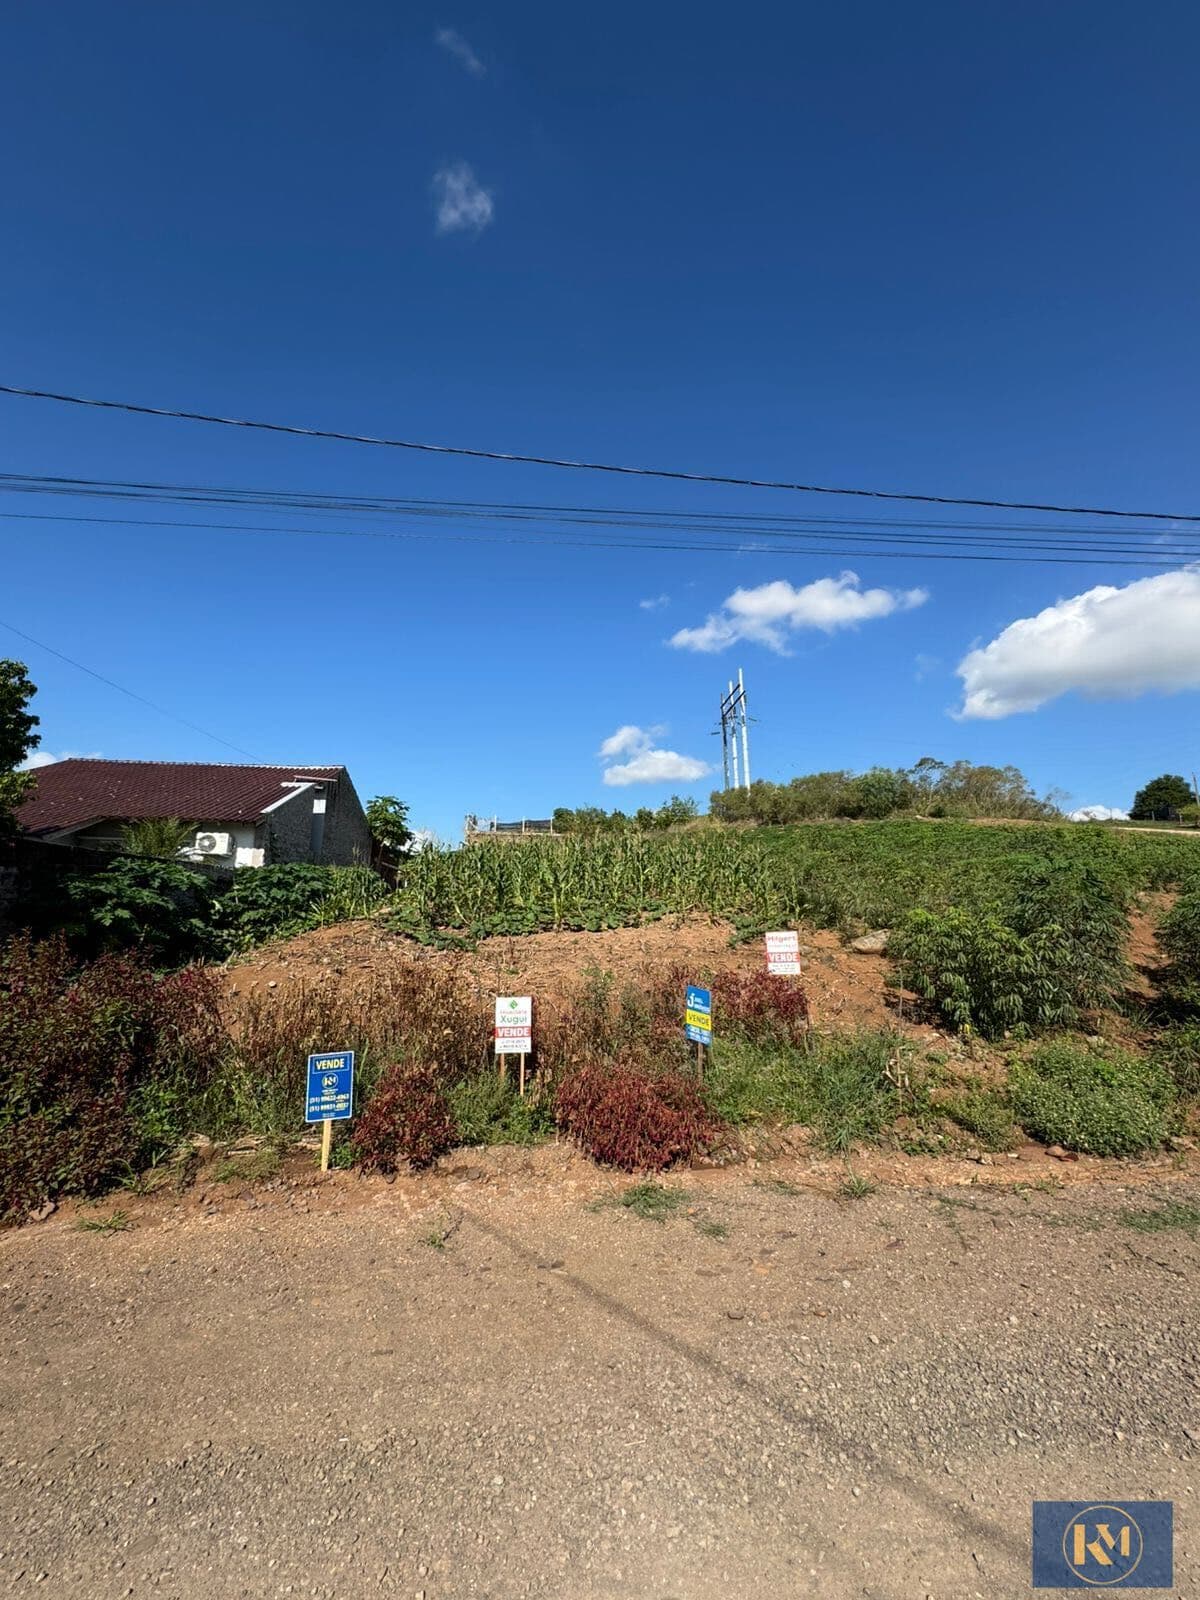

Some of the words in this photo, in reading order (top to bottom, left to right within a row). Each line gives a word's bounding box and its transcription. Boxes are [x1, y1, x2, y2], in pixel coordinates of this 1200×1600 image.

[768, 953, 798, 962] VENDE
[500, 1015, 528, 1025] Xugui
[688, 1012, 710, 1026] VENDE
[498, 1028, 530, 1037] VENDE
[316, 1058, 345, 1070] VENDE
